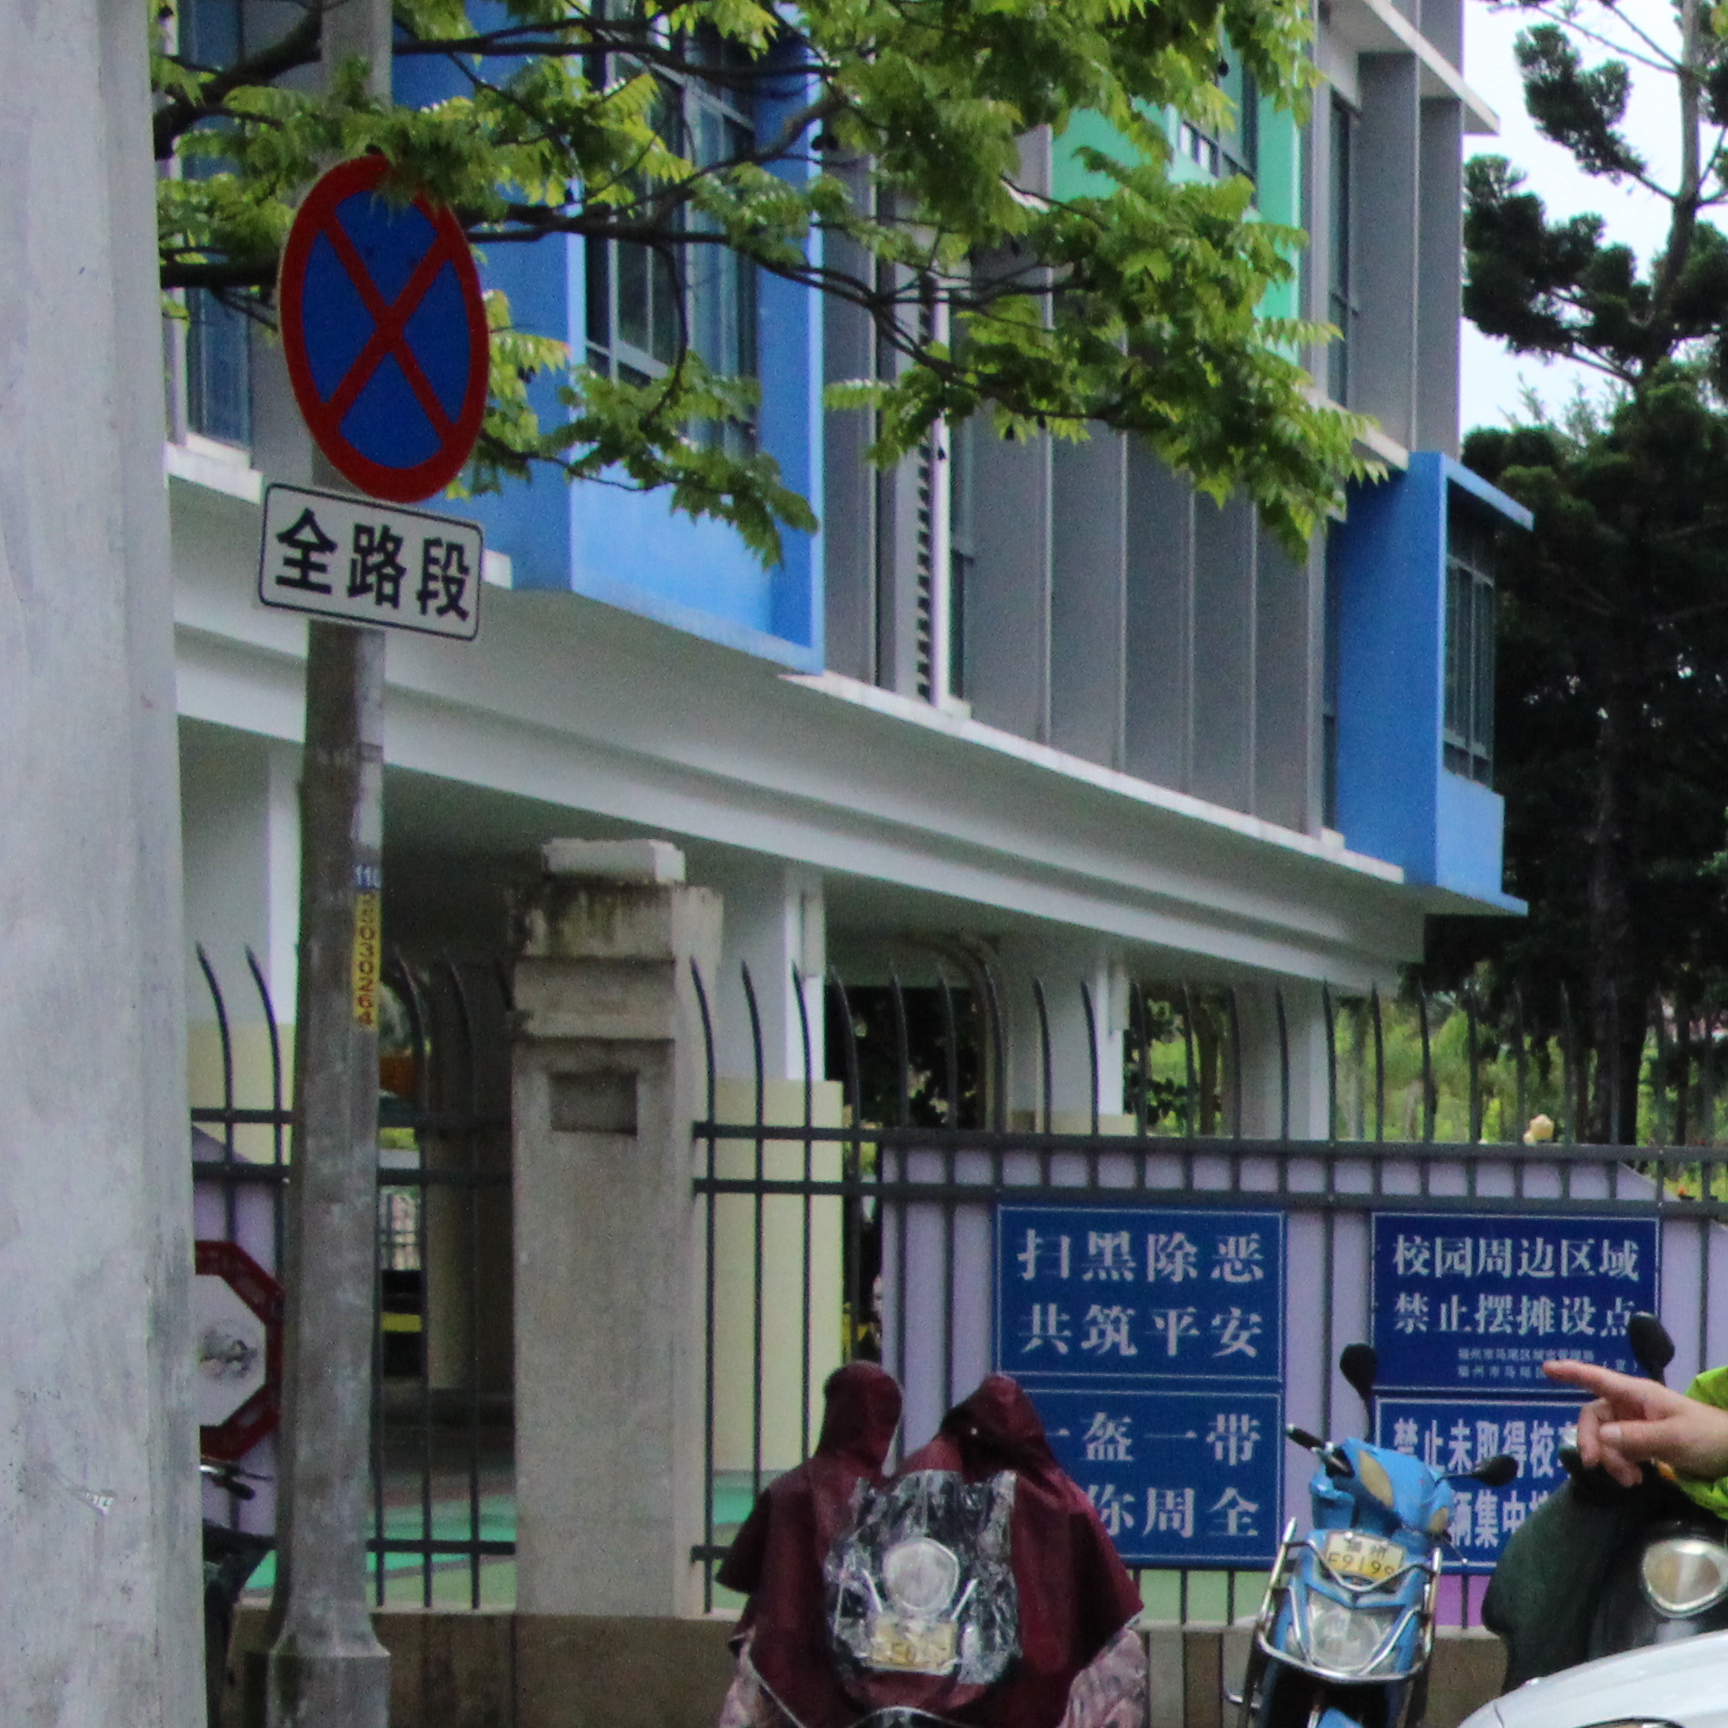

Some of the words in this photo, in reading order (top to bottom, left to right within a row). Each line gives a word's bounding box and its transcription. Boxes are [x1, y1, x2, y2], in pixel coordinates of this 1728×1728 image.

[275, 508, 470, 622] 全路段
[1017, 1228, 1264, 1283] 扫黑除恶
[1393, 1234, 1640, 1282] 校园周边区域
[1018, 1303, 1262, 1358] 共筑平安
[1394, 1291, 1634, 1337] 禁止摆摊设点
